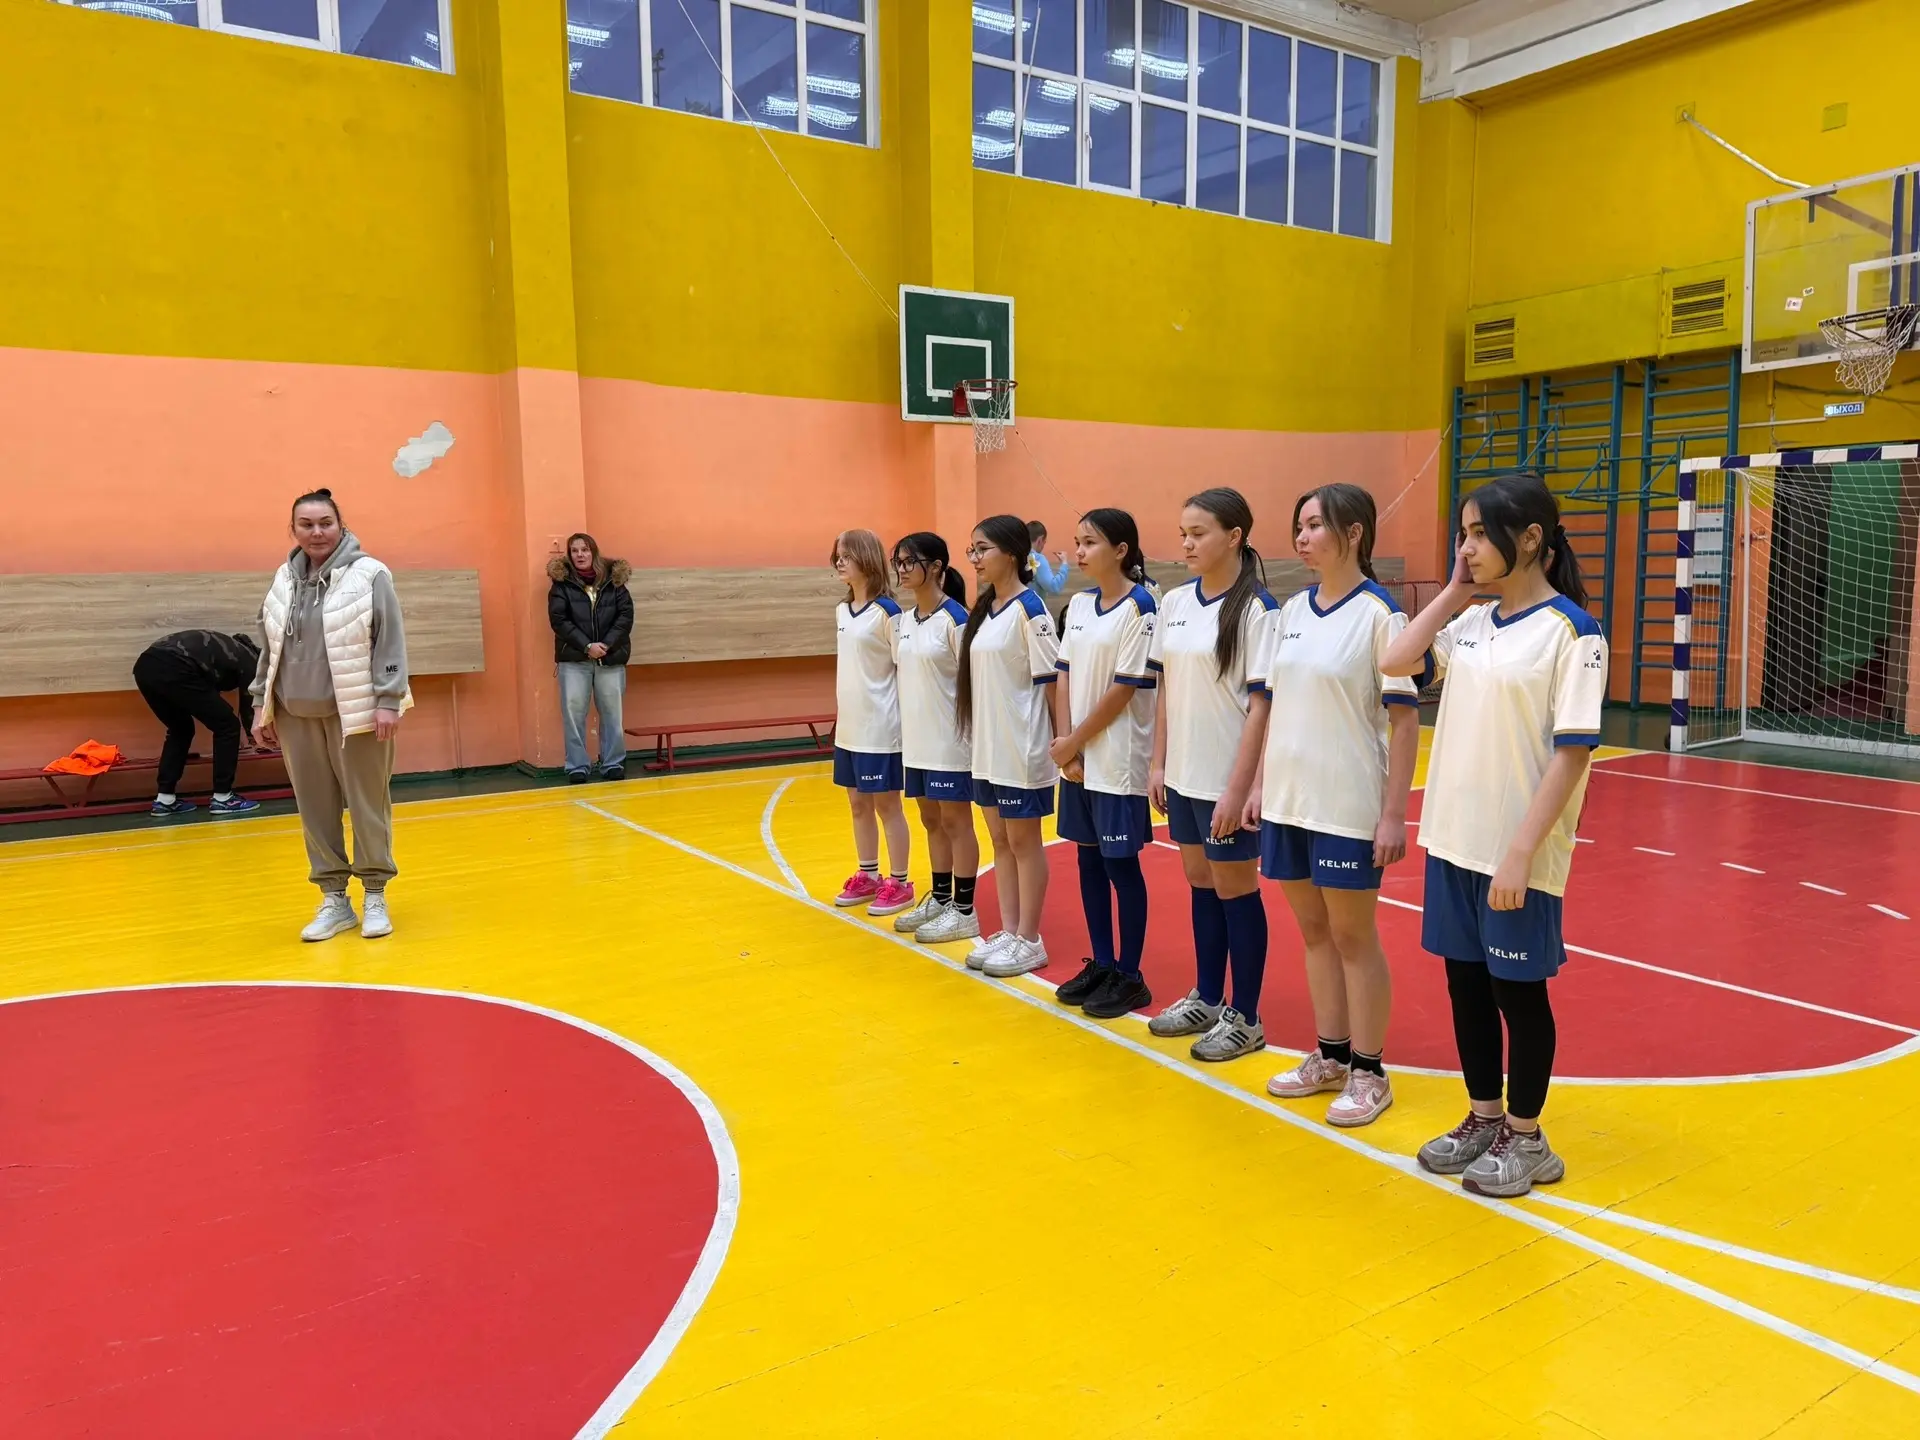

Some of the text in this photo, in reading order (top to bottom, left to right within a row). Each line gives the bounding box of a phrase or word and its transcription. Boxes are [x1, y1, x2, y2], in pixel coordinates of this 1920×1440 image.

[385, 664, 398, 673] ME
[1102, 834, 1128, 842] KELME
[1205, 837, 1235, 845] KELME
[1318, 859, 1358, 869] KELME
[1488, 945, 1528, 961] KELME
